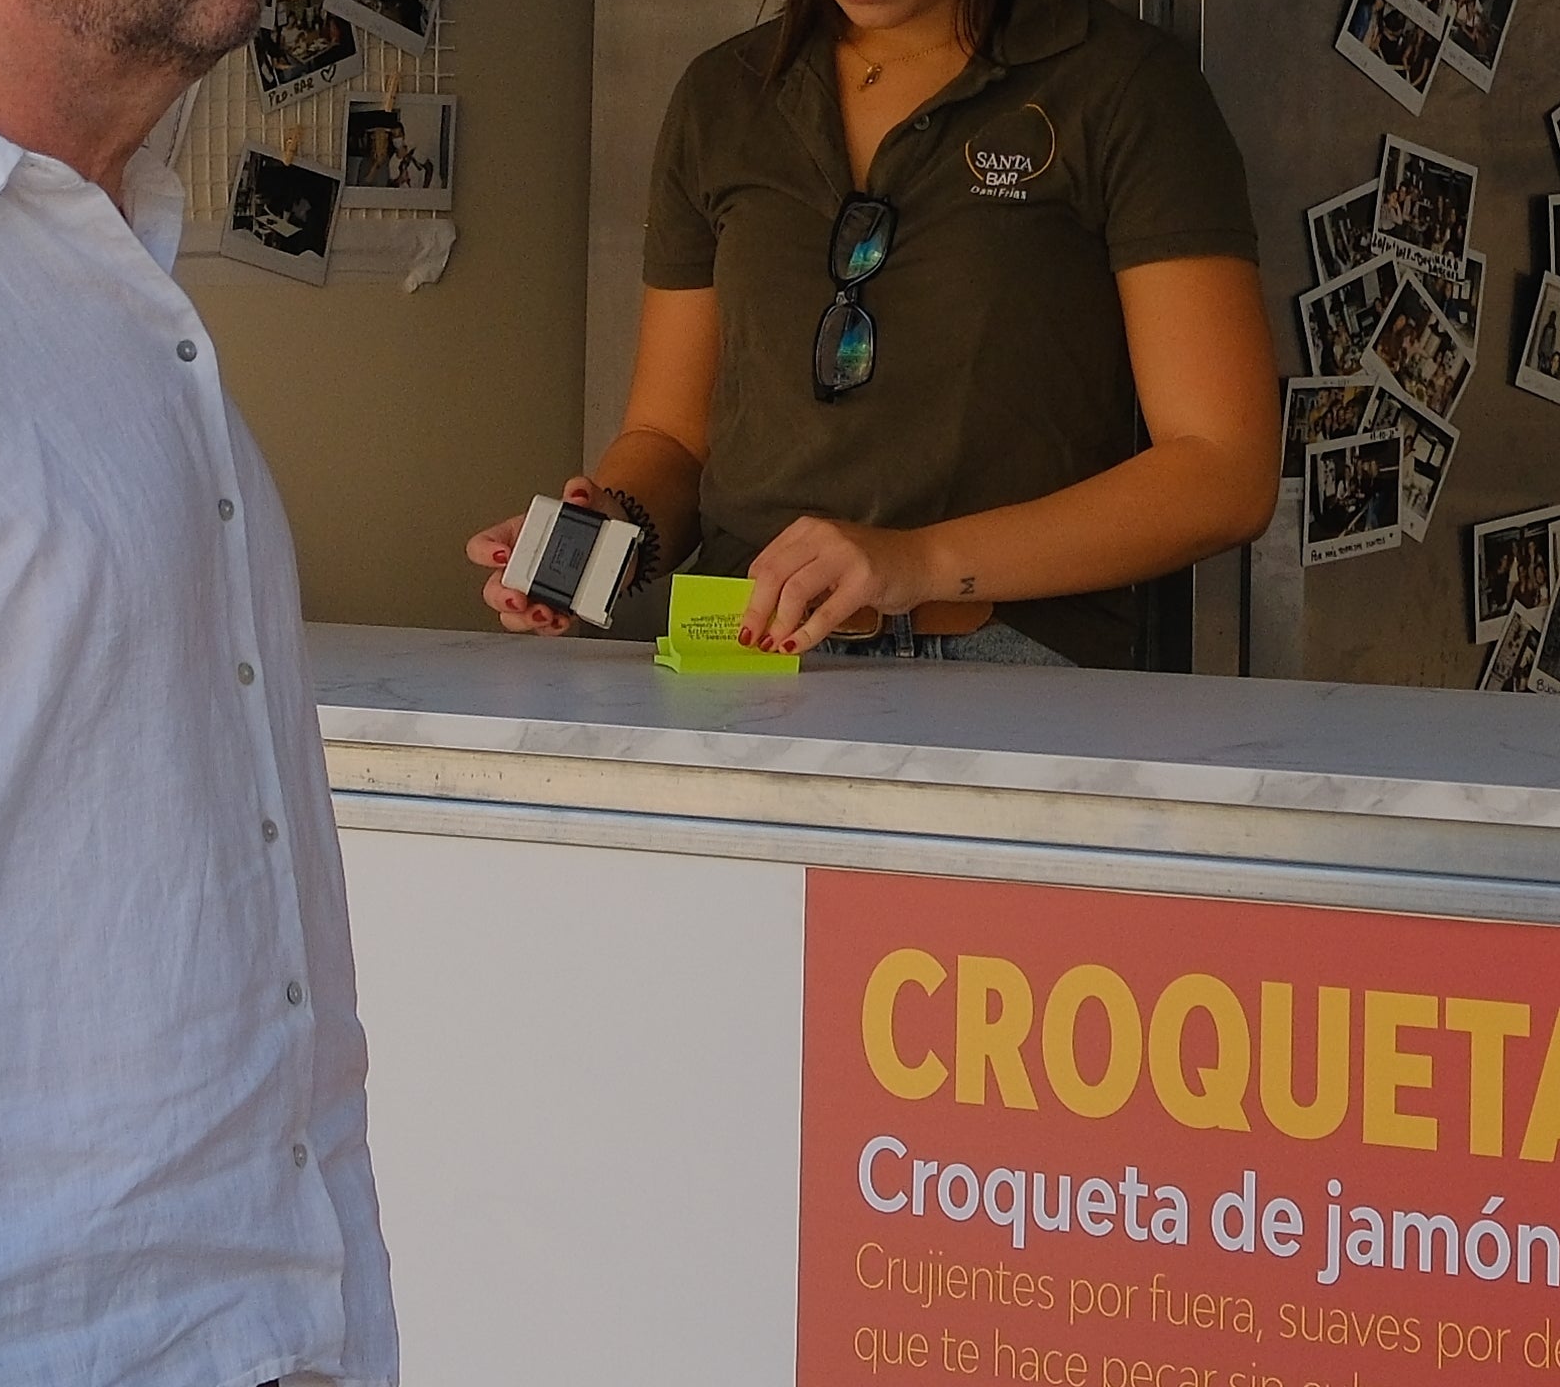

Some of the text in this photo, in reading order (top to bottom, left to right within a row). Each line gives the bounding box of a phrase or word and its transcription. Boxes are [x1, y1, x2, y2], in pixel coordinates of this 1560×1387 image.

[975, 151, 1034, 173] SANTA
[985, 172, 1019, 187] BAR
[857, 1135, 1188, 1248] Croqueta
[1210, 1171, 1303, 1257] de
[854, 1242, 1054, 1310] Crujientes
[1069, 1276, 1138, 1325] por
[1150, 1273, 1263, 1343] fuera,
[1279, 1303, 1422, 1353] suaves
[1438, 1319, 1511, 1369] por
[853, 1325, 929, 1373] que
[940, 1327, 980, 1373] te
[993, 1328, 1089, 1386] hace
